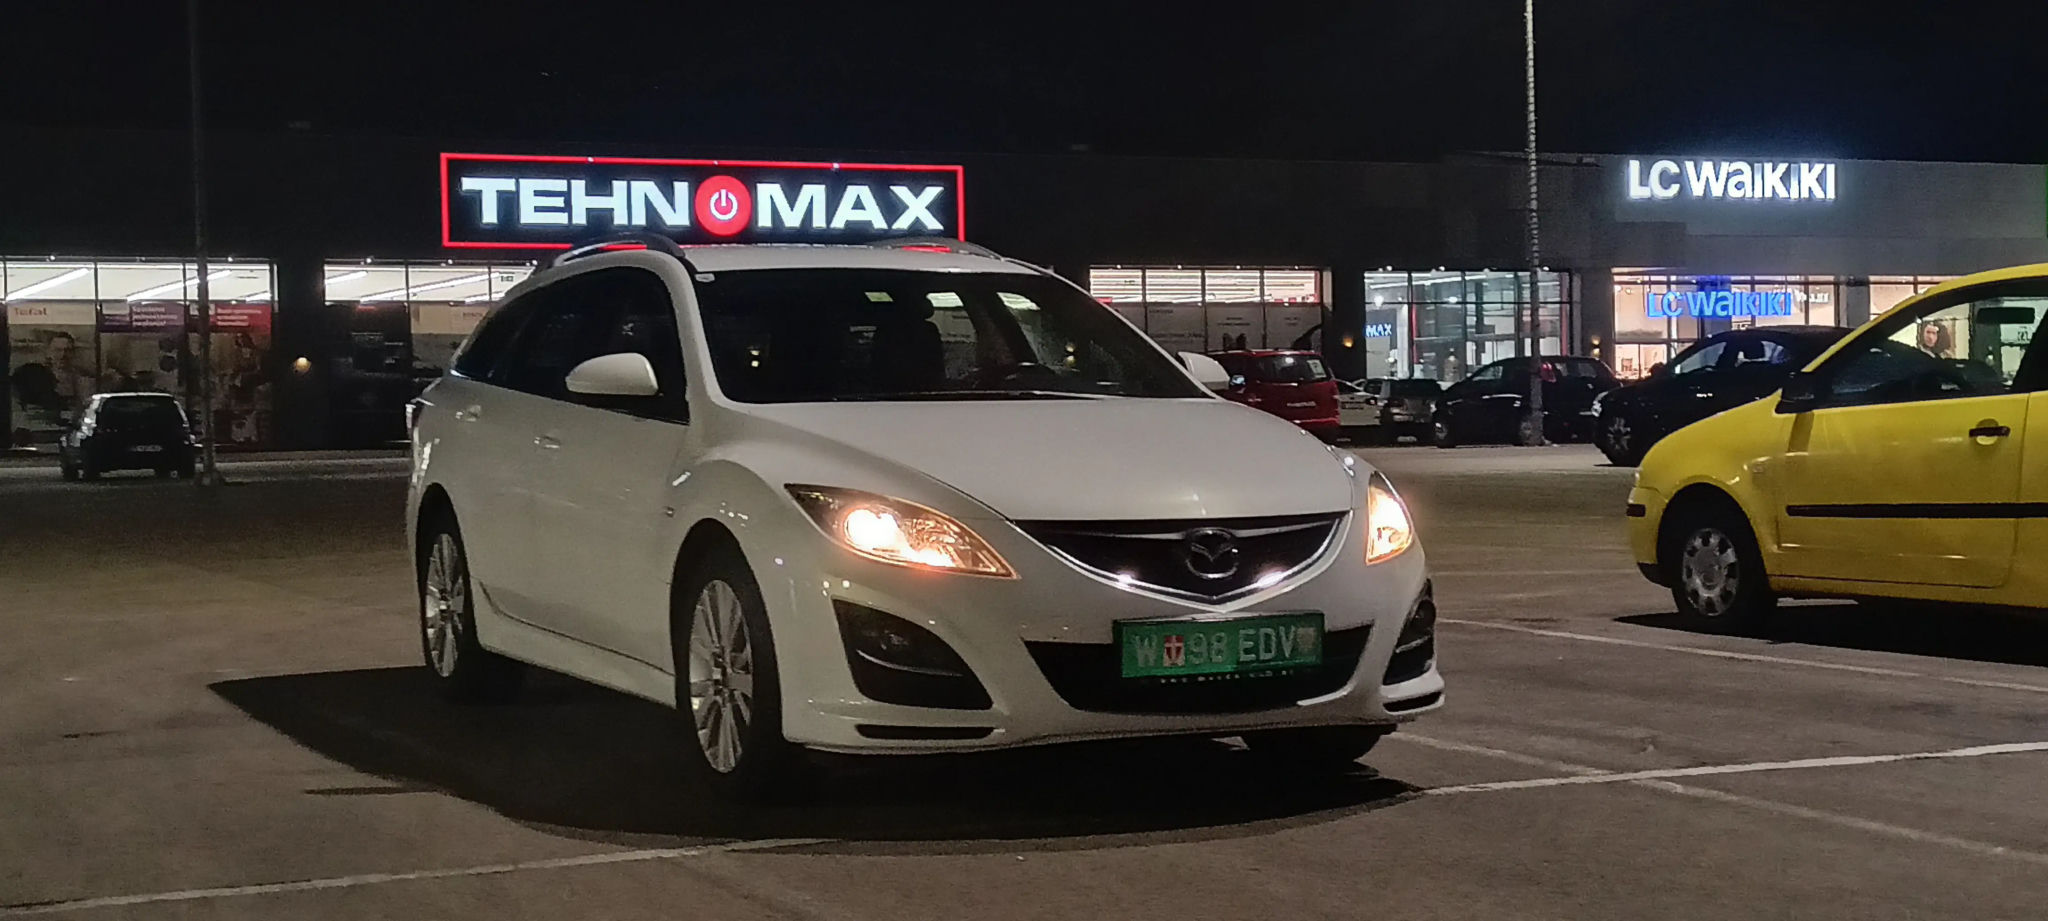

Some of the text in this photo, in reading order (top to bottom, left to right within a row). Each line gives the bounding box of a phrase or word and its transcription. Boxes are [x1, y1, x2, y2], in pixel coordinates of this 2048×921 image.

[1628, 159, 1680, 199] LC
[1646, 291, 1683, 317] LC
[1134, 625, 1296, 668] W 98 EDV
